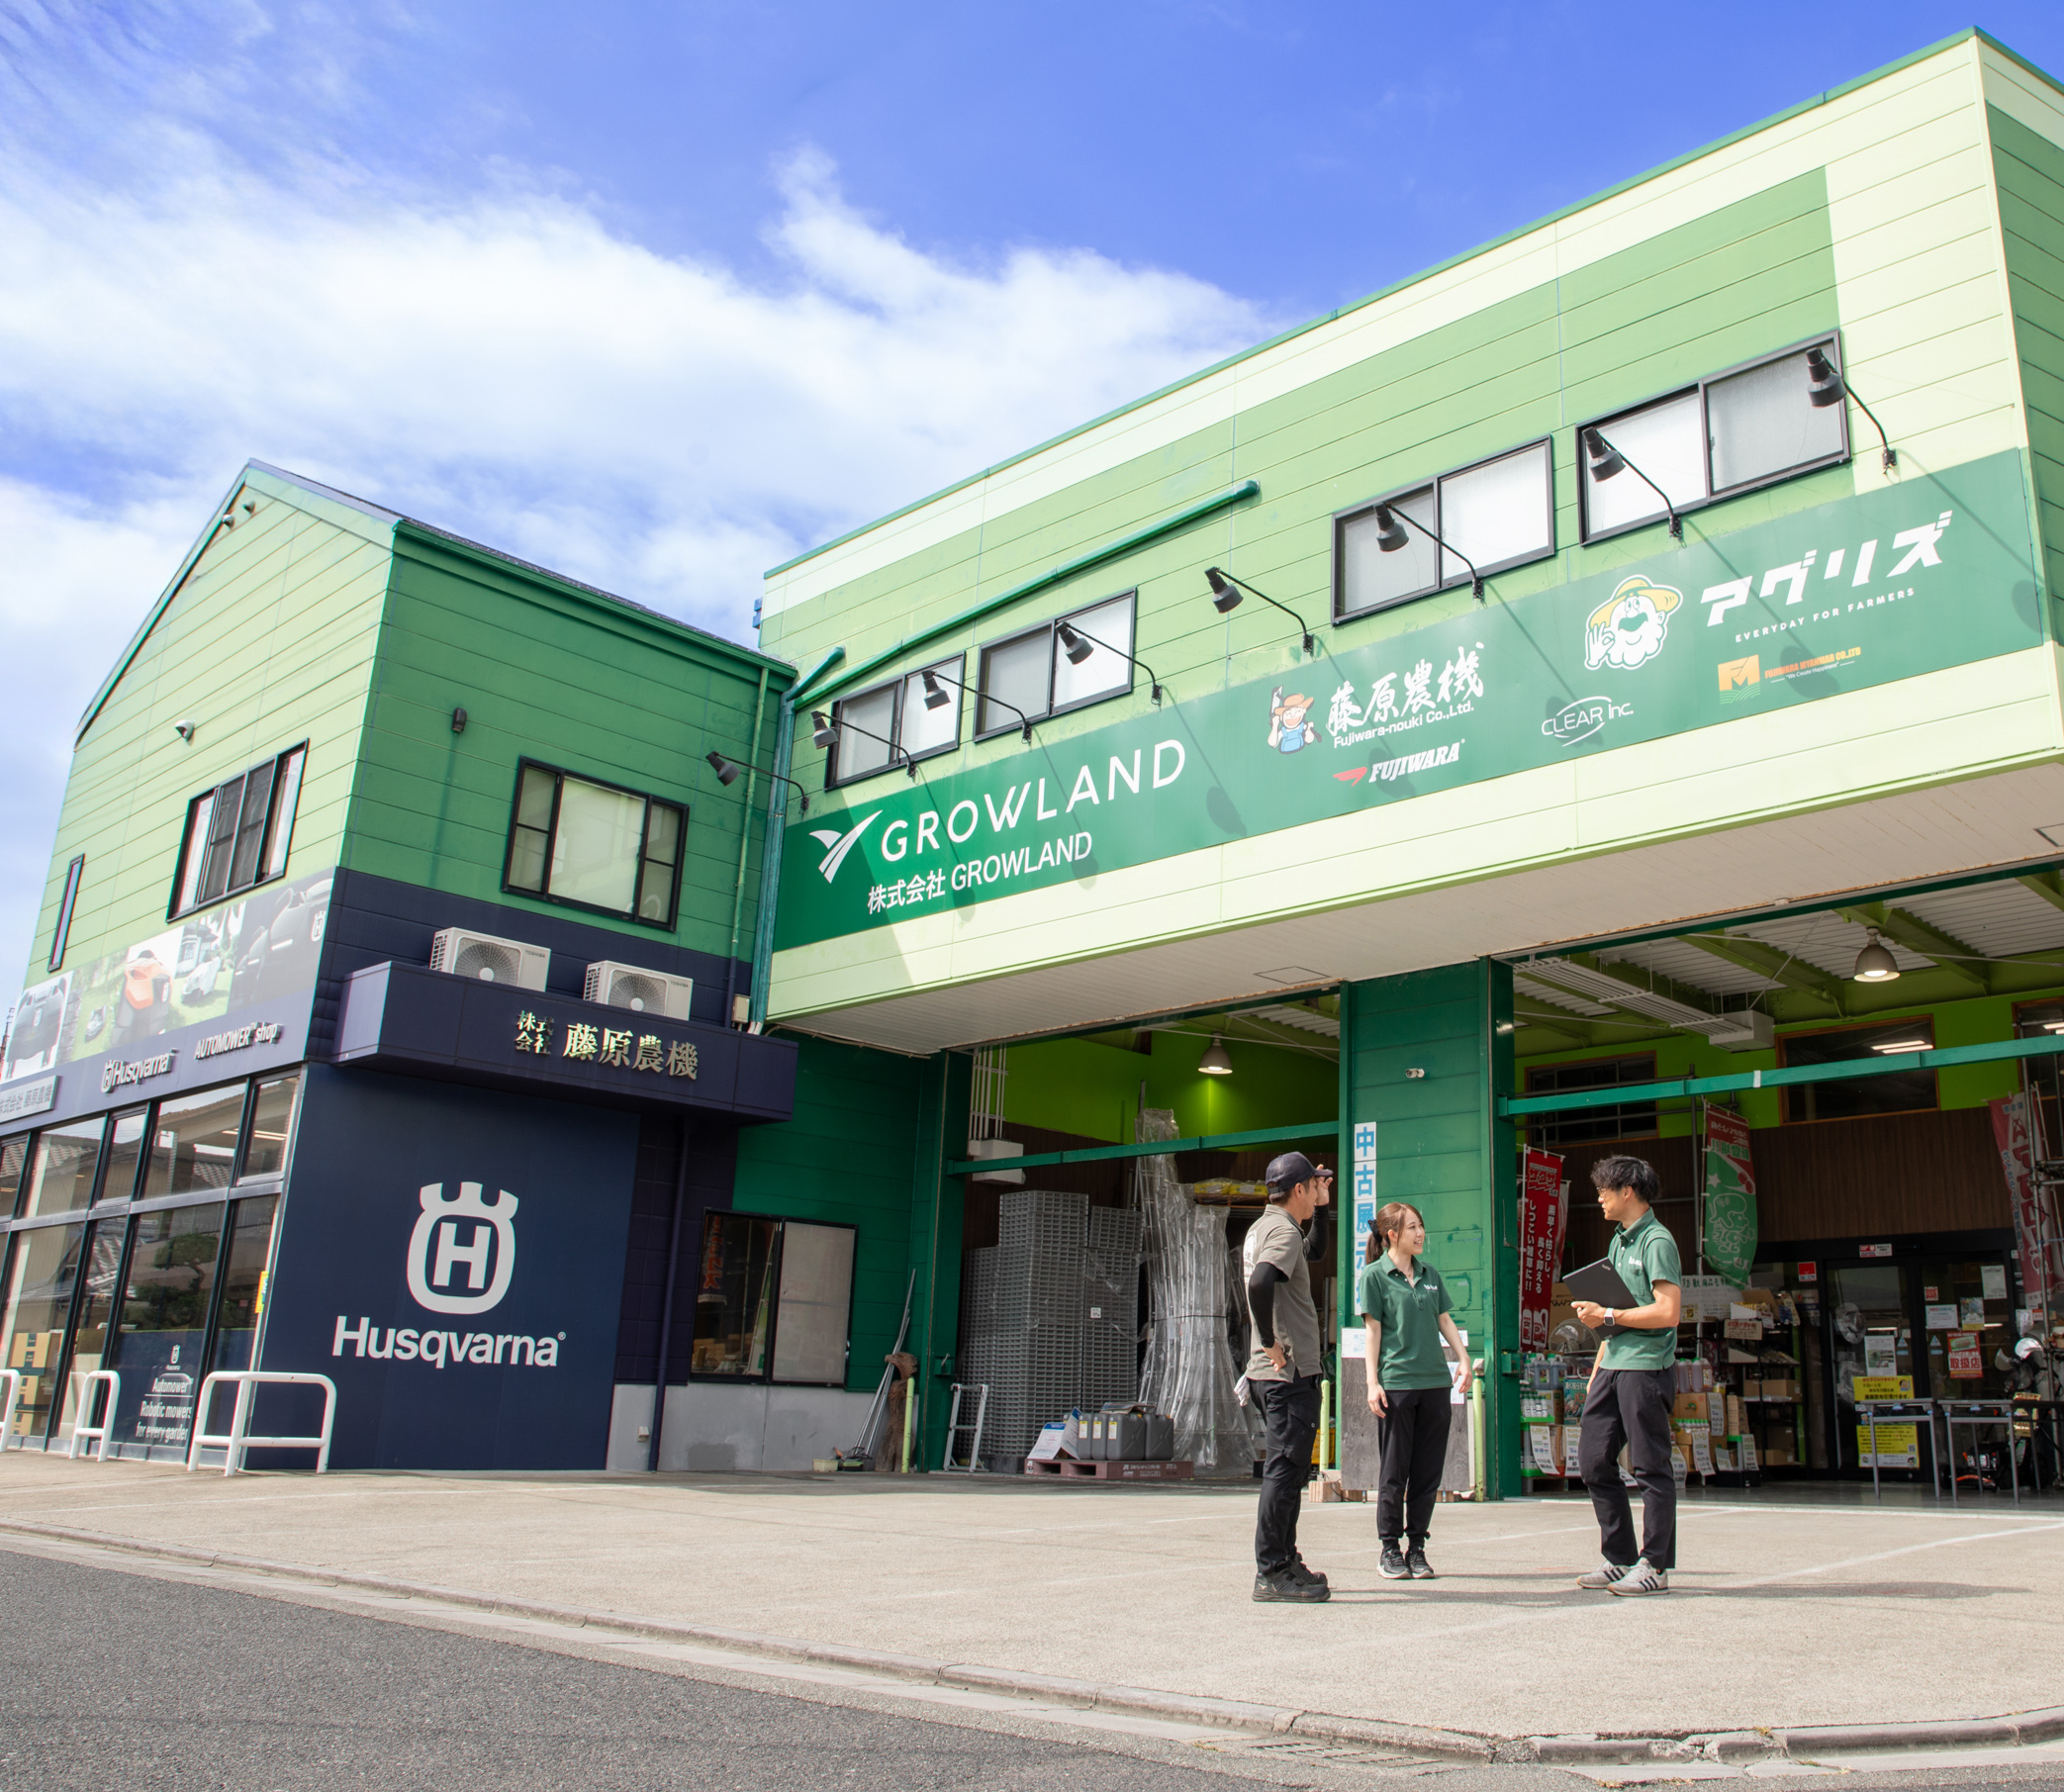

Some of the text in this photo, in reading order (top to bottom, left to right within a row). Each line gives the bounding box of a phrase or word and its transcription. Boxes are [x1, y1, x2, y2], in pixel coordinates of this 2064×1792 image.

[1701, 510, 1952, 627] アグリズ
[1736, 588, 1916, 643] EVERYDAY FOR FARMERS
[1764, 662, 1800, 679] FUJIWARA
[1800, 653, 1835, 670] MYANMAR
[1796, 669, 1813, 678] Create
[1325, 641, 1485, 737] 藤原農機
[1333, 703, 1474, 749] Fujiwara-nouki Co.,Ltd.
[1541, 699, 1635, 737] CLEAR Inc.
[1368, 742, 1459, 783] FUJIWARA
[881, 739, 1186, 862] GROWLAND
[867, 831, 1092, 915] 株式会社 GROWLAND
[524, 949, 546, 958] TOSHIBA
[670, 980, 690, 989] TOSHIBA
[254, 1021, 281, 1044] shop
[516, 1009, 555, 1036] 株式
[515, 1031, 552, 1056] 会社
[563, 1022, 700, 1081] 藤原農機
[112, 1053, 172, 1086] Husqvarna
[1355, 1126, 1376, 1308] 中古展示
[331, 1315, 559, 1368] Husqvarna
[1949, 1357, 1981, 1369] 取扱店
[140, 1400, 165, 1418] Robotic
[136, 1421, 146, 1438] for
[145, 1425, 166, 1442] every
